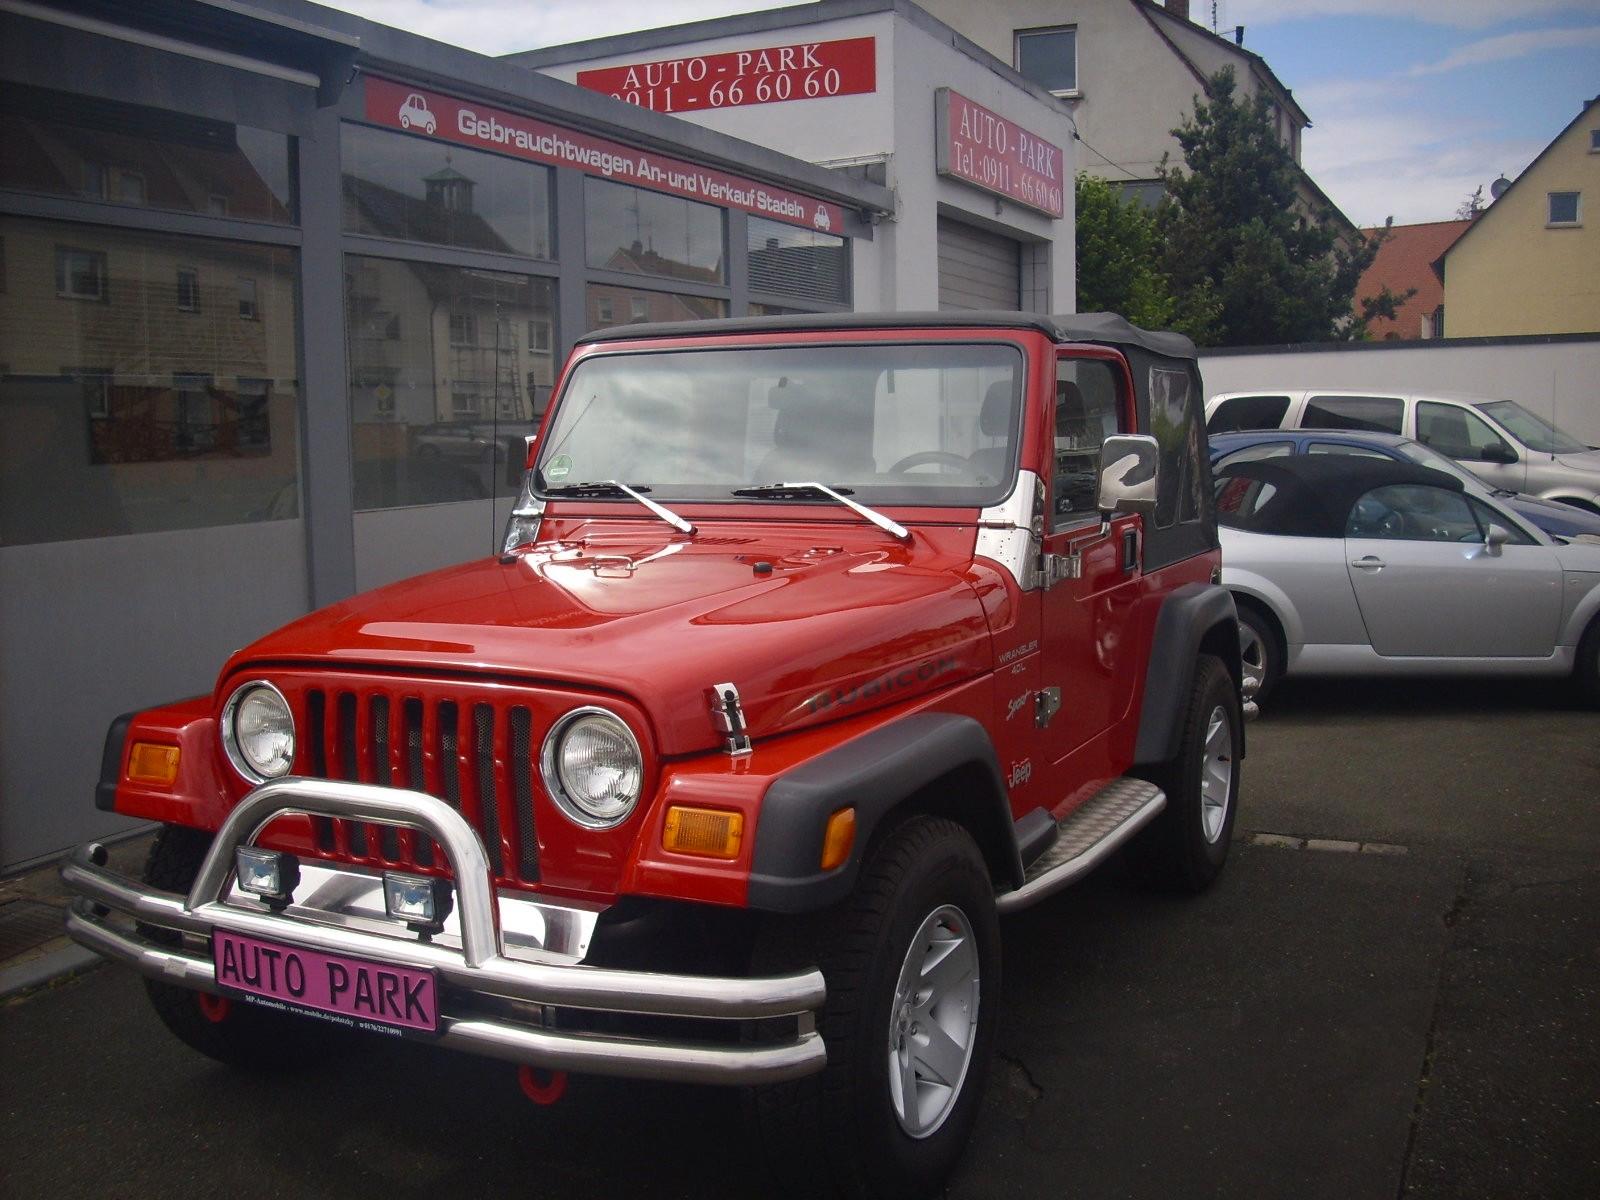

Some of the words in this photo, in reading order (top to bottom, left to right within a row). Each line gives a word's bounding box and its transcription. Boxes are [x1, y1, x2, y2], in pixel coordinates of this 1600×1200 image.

[623, 58, 707, 89] AUTO
[737, 44, 823, 75] PARK
[709, 77, 744, 107] 66
[755, 74, 791, 102] 60
[804, 68, 840, 97] 60
[960, 103, 1007, 154] AUTO
[1020, 133, 1055, 179] PARK
[458, 109, 634, 175] Gebrauchtwagen
[700, 174, 755, 207] Verkauf
[757, 191, 805, 219] Stadeln
[999, 639, 1038, 663] WRANGLER
[1008, 761, 1031, 788] Jeep
[222, 938, 306, 998] AUTO
[326, 961, 429, 1023] PARK
